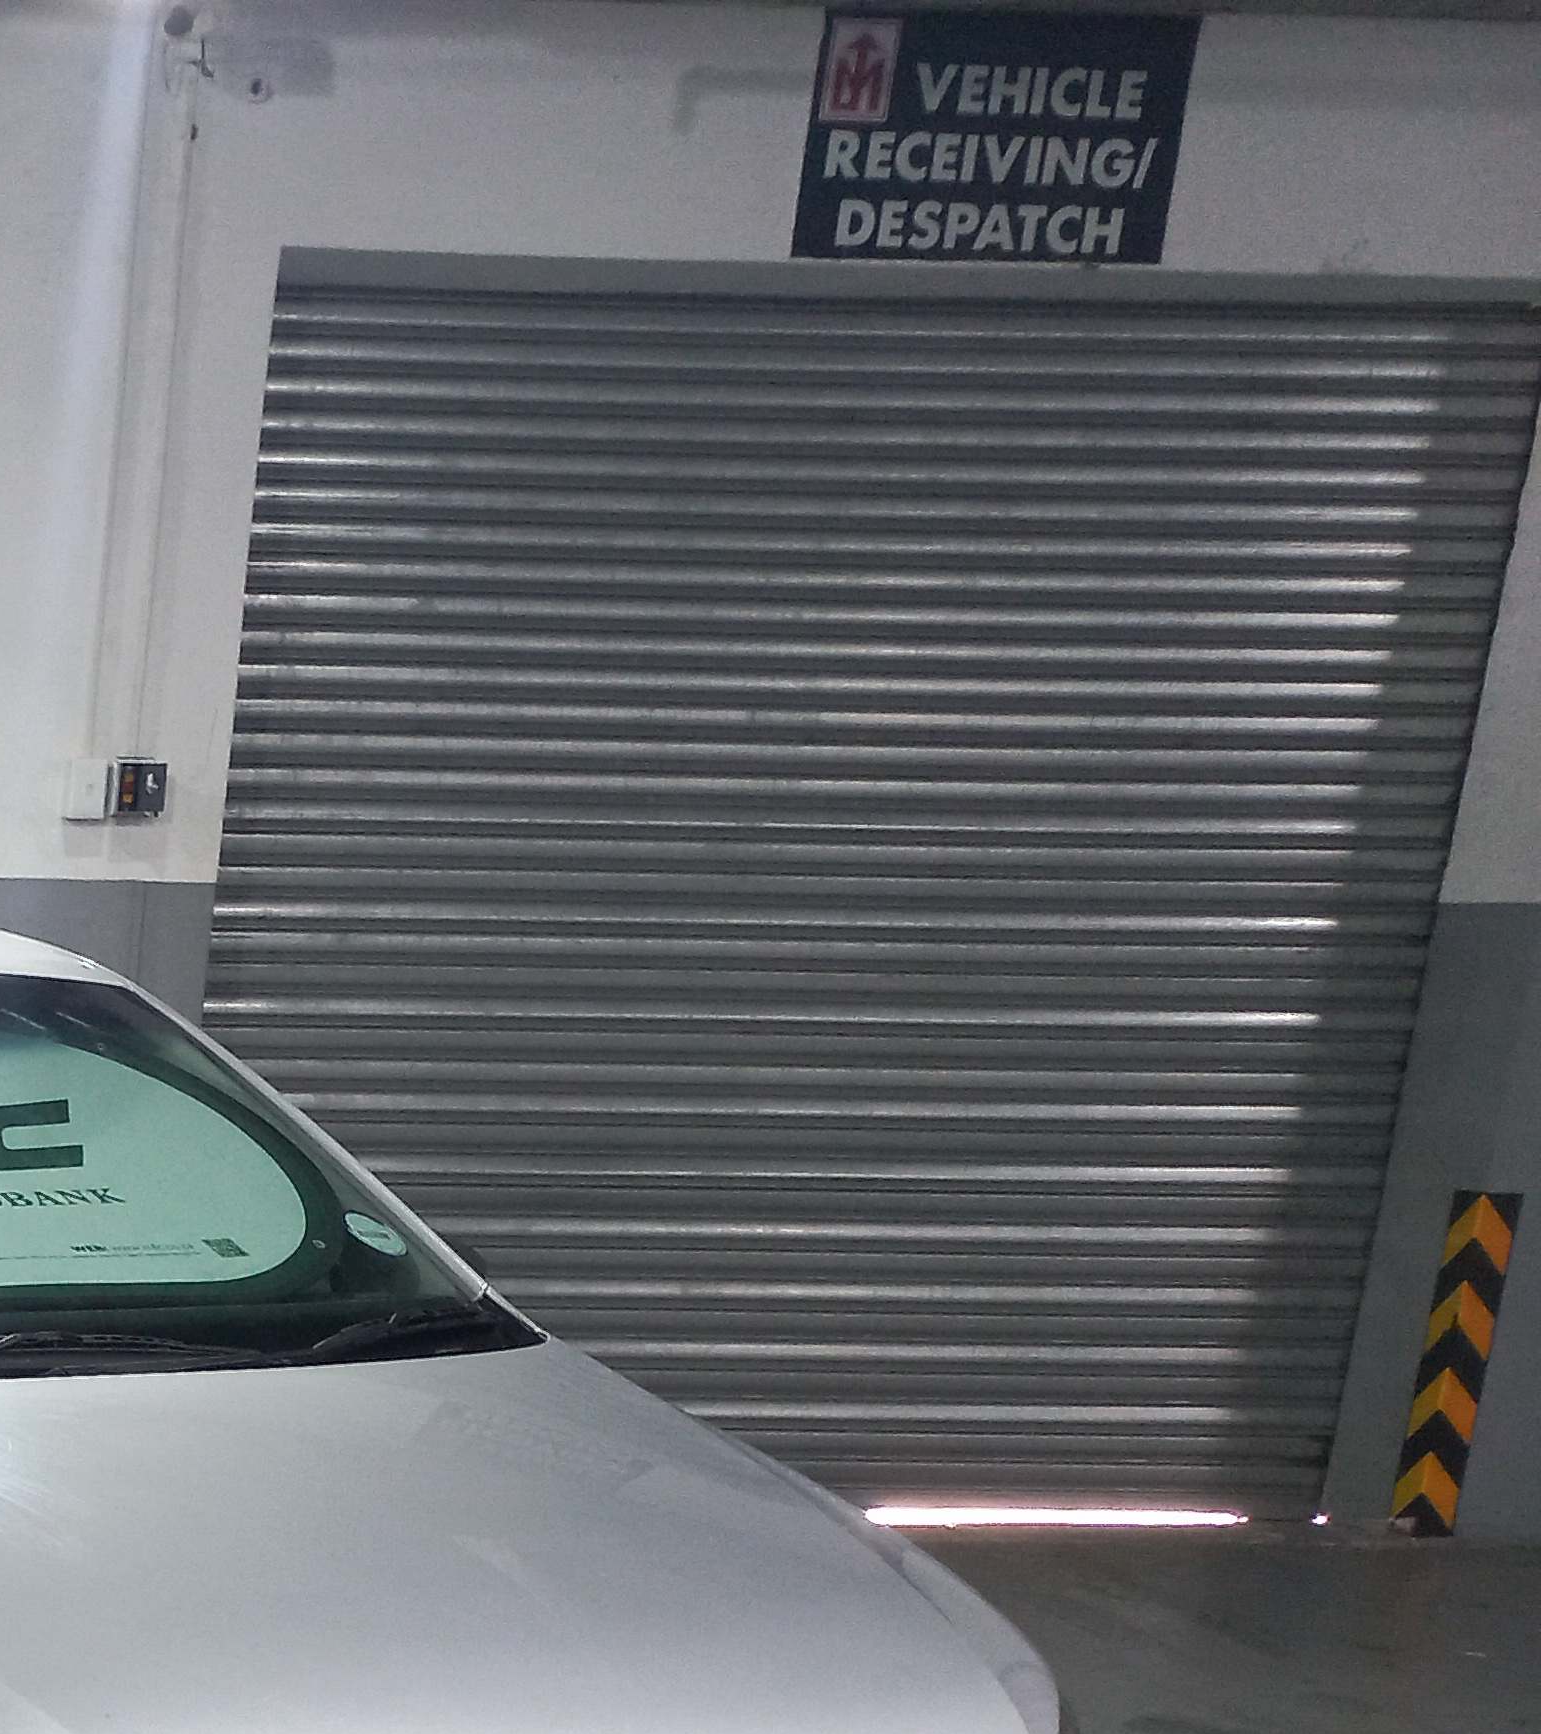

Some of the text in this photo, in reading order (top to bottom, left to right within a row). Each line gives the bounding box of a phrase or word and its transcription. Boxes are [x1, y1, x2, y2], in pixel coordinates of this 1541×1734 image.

[917, 61, 1149, 121] VEHICLE
[822, 128, 1159, 190] RECEIVING/
[833, 198, 1126, 255] DESPATCH
